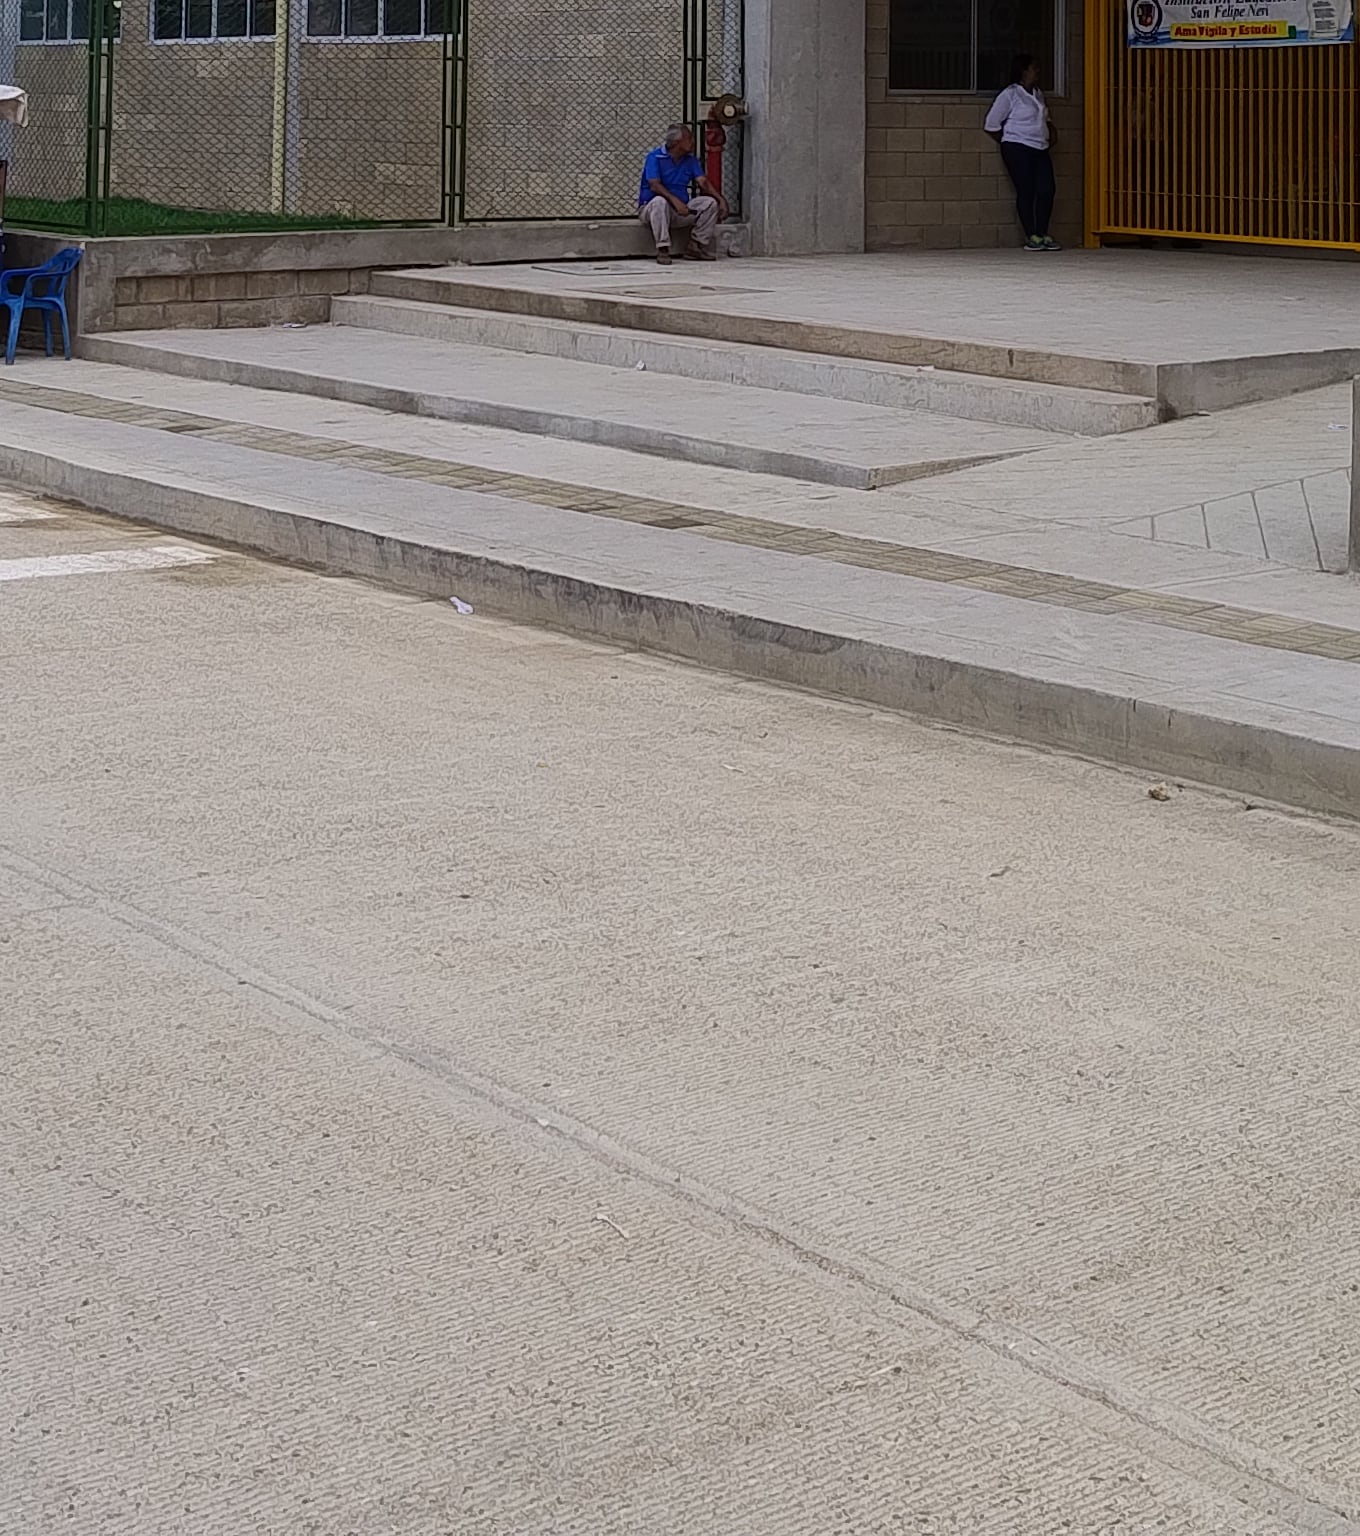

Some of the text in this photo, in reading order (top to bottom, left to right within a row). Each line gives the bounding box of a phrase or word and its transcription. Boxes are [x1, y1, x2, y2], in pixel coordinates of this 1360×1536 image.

[1191, 4, 1269, 21] San Felipe Neri
[1174, 24, 1277, 38] Ama Vigila y Estudia
